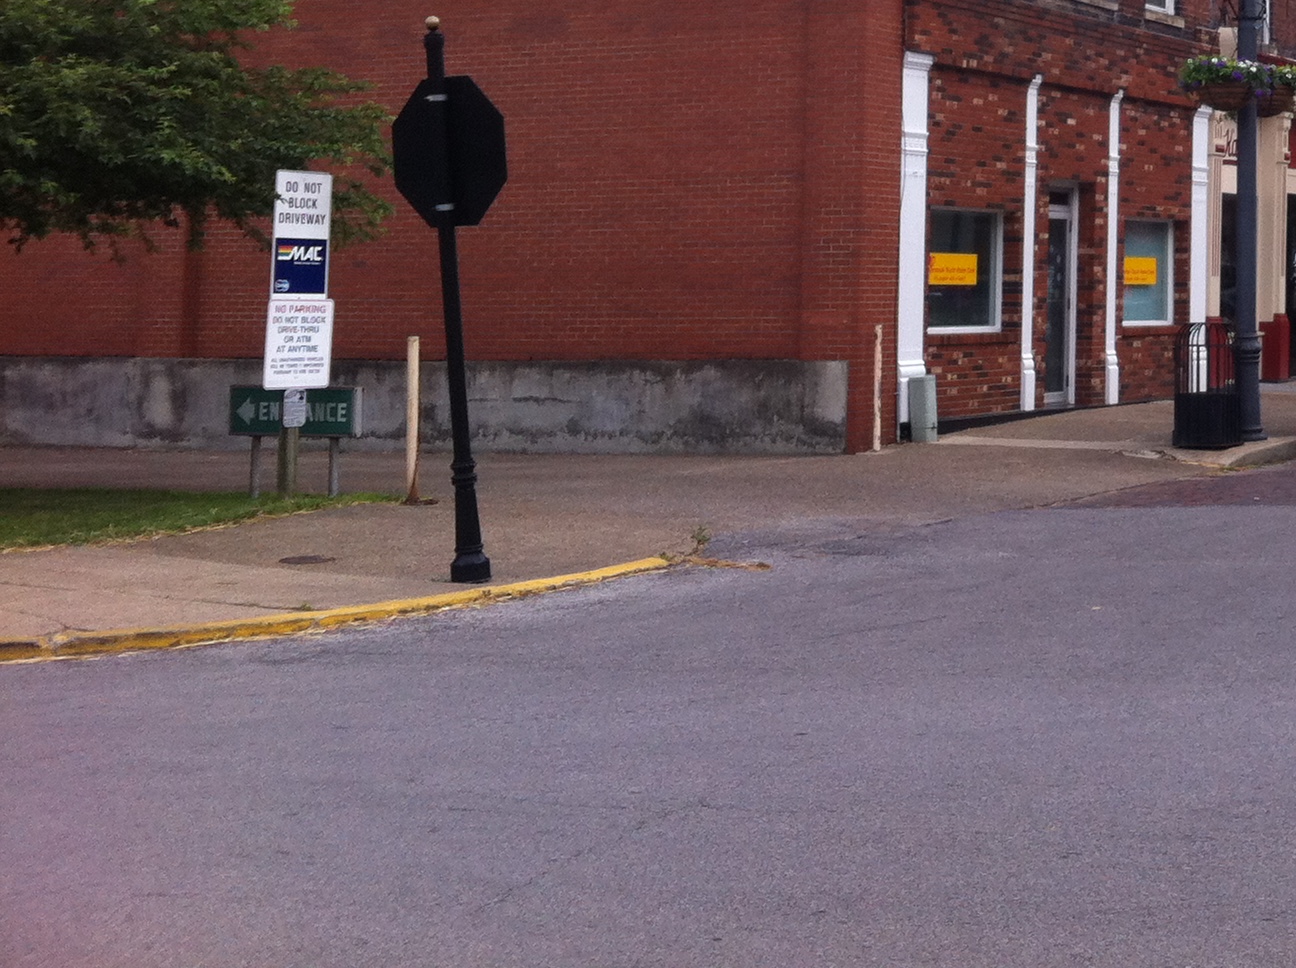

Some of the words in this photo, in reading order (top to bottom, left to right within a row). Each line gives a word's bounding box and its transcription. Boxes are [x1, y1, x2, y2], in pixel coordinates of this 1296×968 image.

[285, 180, 299, 194] DO
[303, 182, 323, 194] NOT
[288, 196, 318, 210] BLOCK
[278, 212, 327, 225] DRIVEWAY
[284, 245, 323, 261] MAC
[289, 304, 327, 314] PARKING
[300, 316, 326, 324] BLOCK
[296, 335, 312, 343] ATM
[287, 344, 319, 353] ANYTIME
[259, 401, 348, 423] ENANCE
